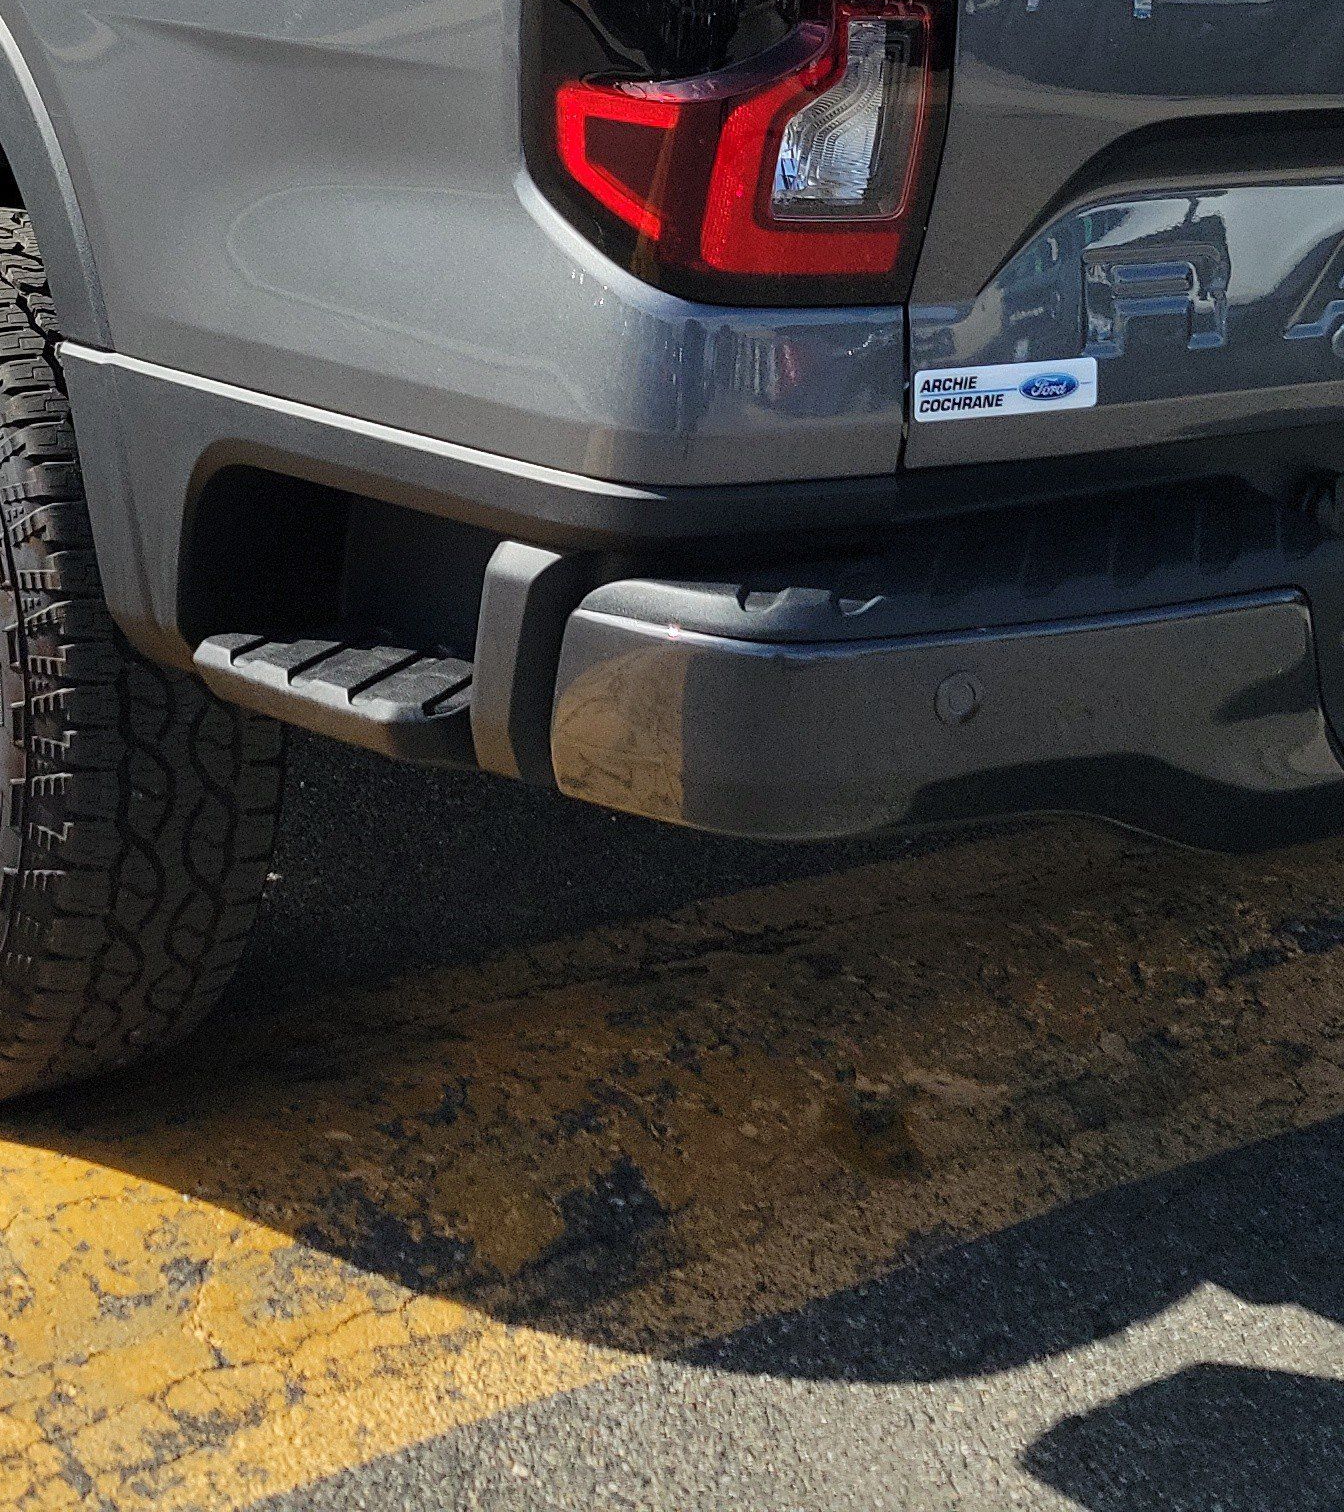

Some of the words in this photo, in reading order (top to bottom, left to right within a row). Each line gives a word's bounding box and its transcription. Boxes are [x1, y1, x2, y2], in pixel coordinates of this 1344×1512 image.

[920, 376, 978, 394] ARCHIE
[1030, 378, 1068, 397] Ford
[919, 394, 1004, 414] COCHRANE
